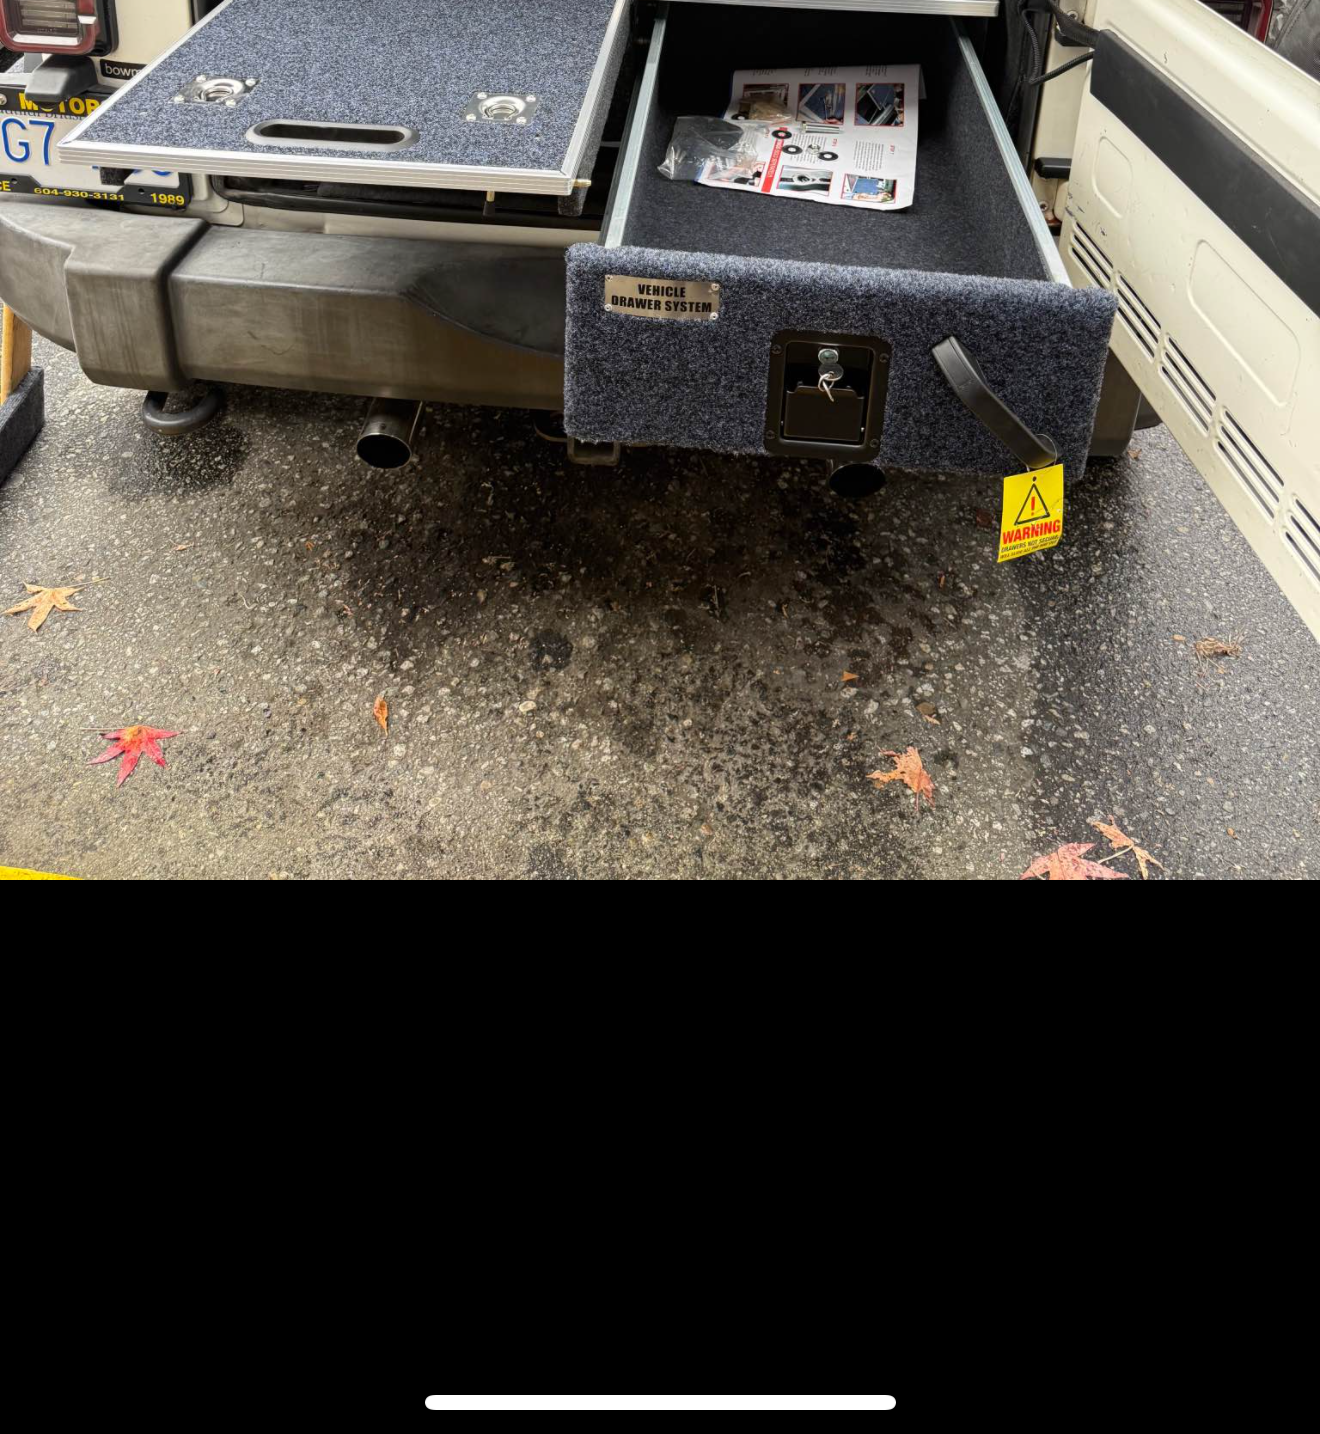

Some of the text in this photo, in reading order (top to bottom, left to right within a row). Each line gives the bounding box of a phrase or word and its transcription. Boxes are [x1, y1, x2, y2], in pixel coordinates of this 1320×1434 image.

[1, 117, 55, 165] G7
[34, 187, 125, 201] 604-930-3131
[150, 192, 185, 206] 1989
[637, 283, 686, 298] VEHICLE
[611, 295, 713, 313] DRAWER SYSTEM
[1002, 519, 1061, 545] WARNING
